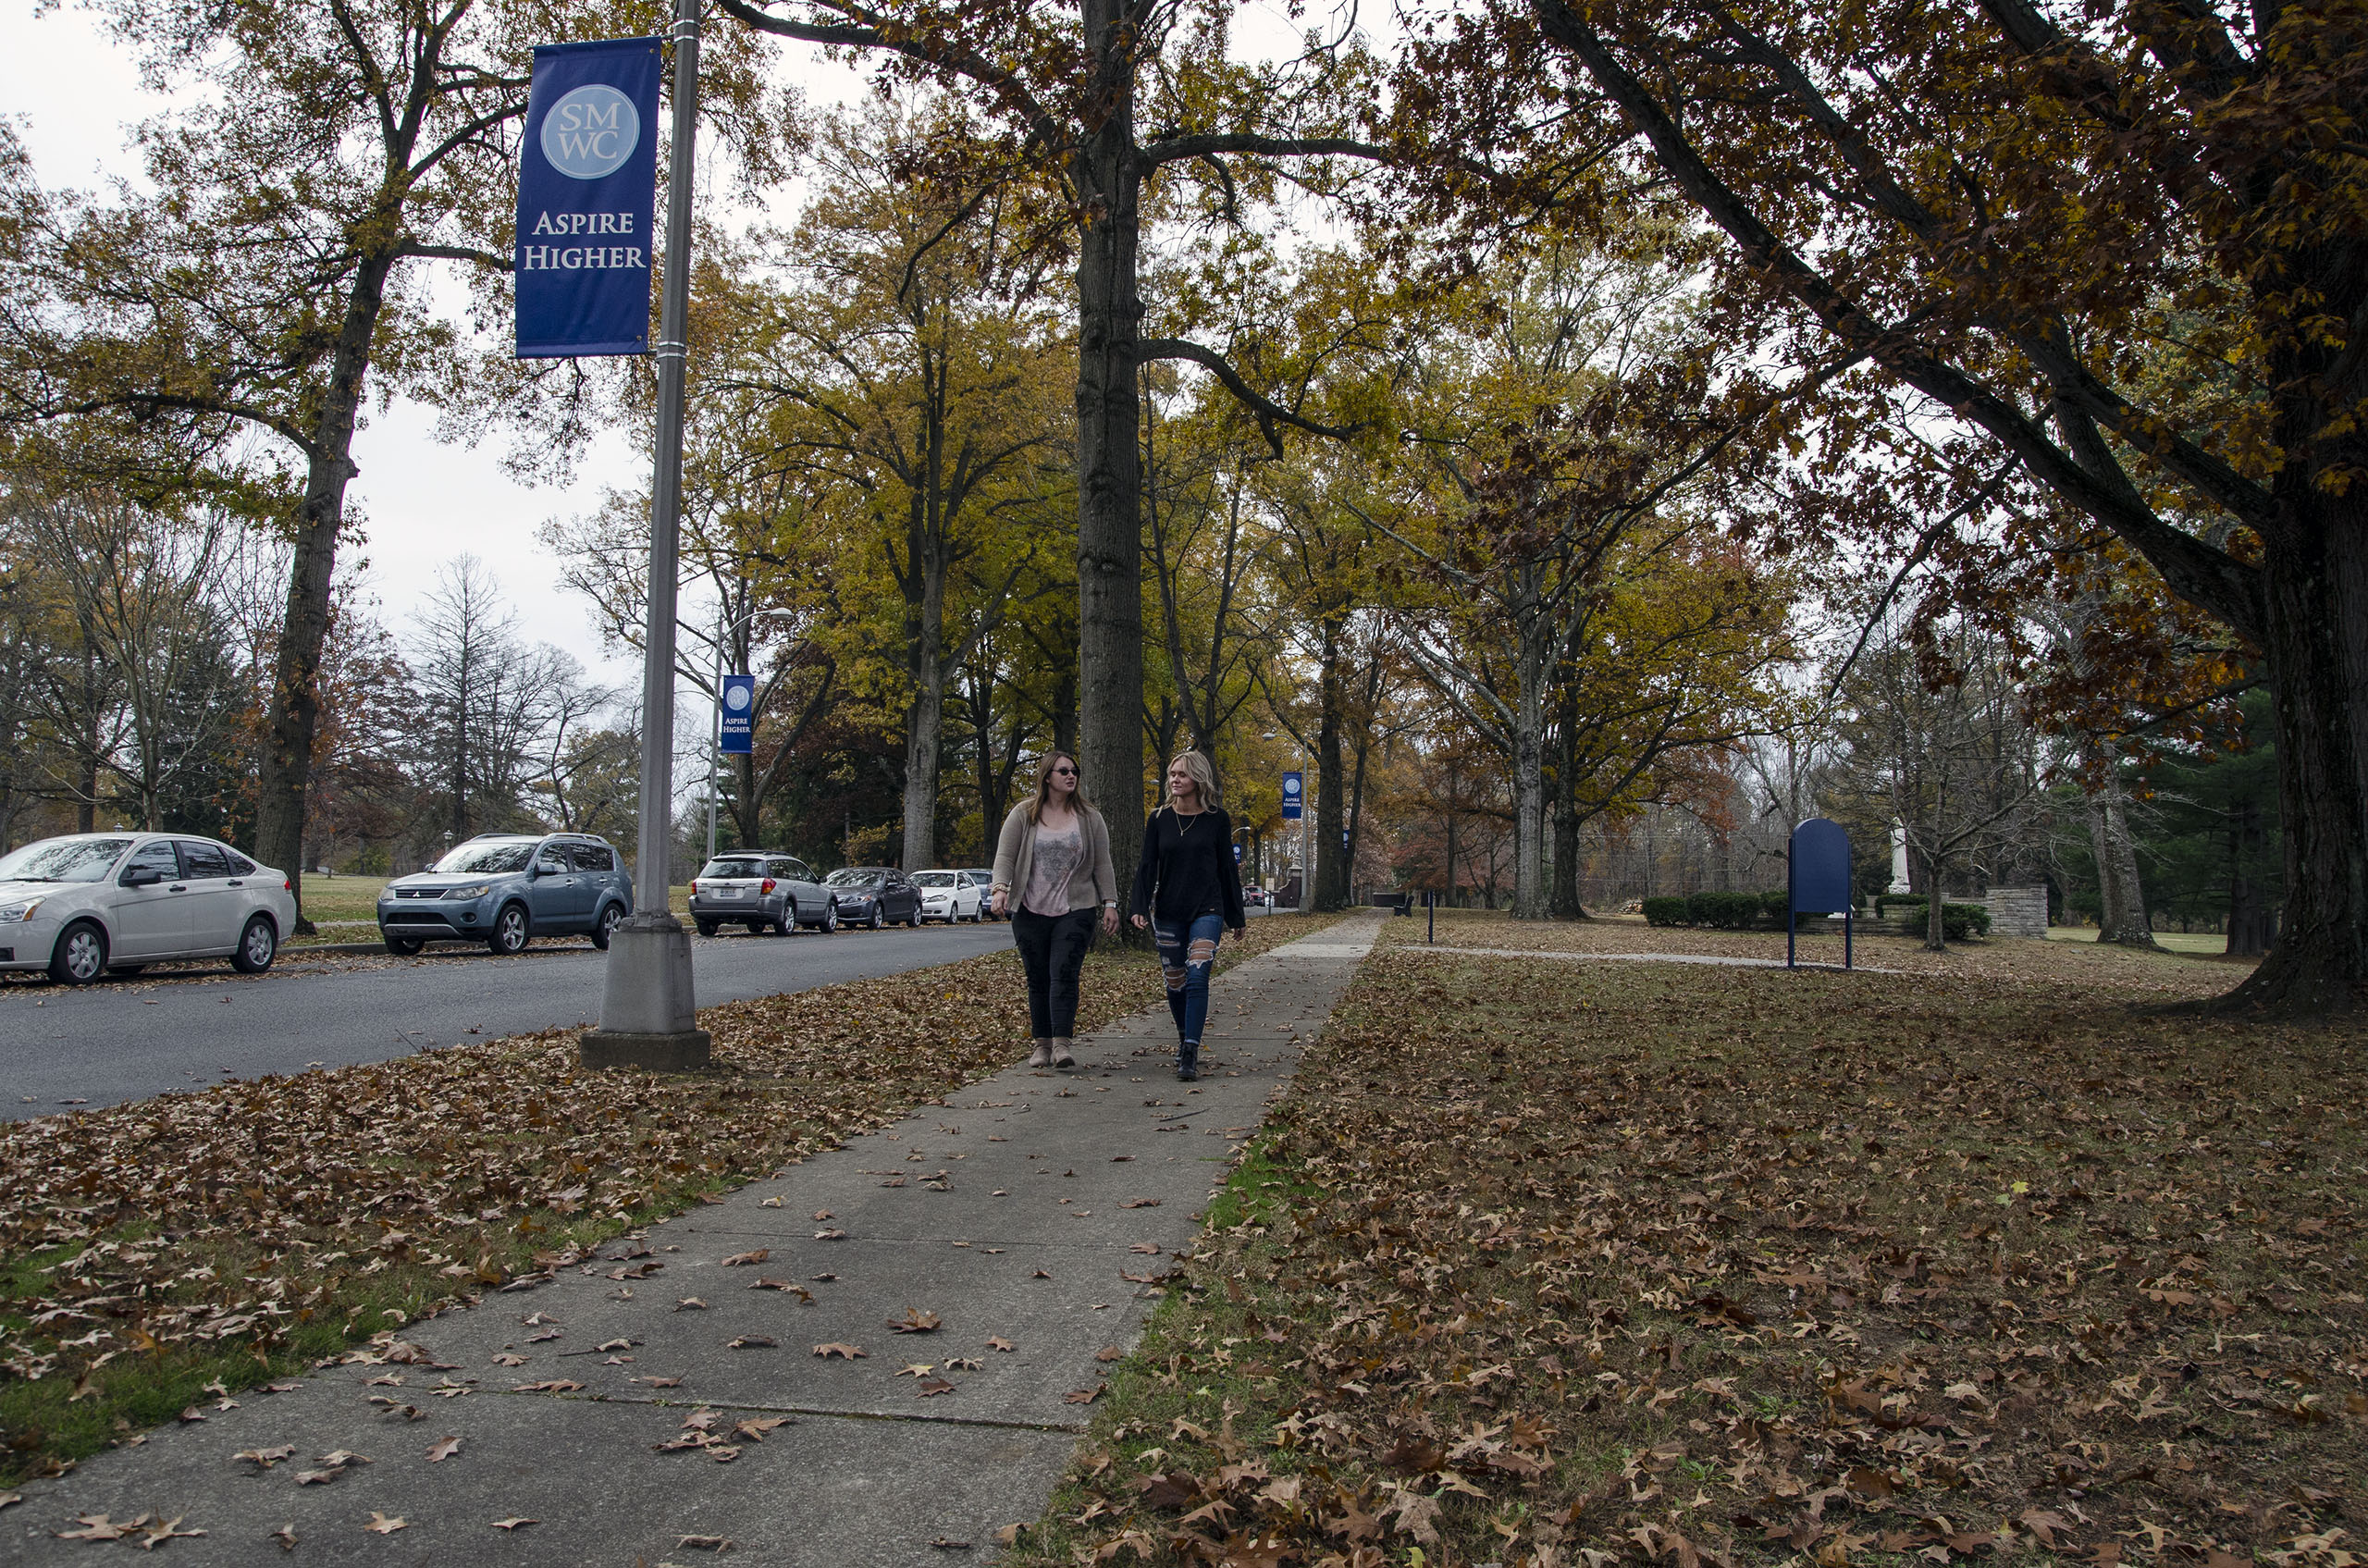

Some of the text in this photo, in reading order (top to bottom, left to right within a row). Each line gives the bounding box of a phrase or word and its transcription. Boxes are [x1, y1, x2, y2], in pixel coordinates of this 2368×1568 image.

[560, 102, 621, 131] SM
[558, 130, 619, 160] WC
[531, 210, 635, 236] ASPIRE
[524, 245, 647, 270] HIGHER
